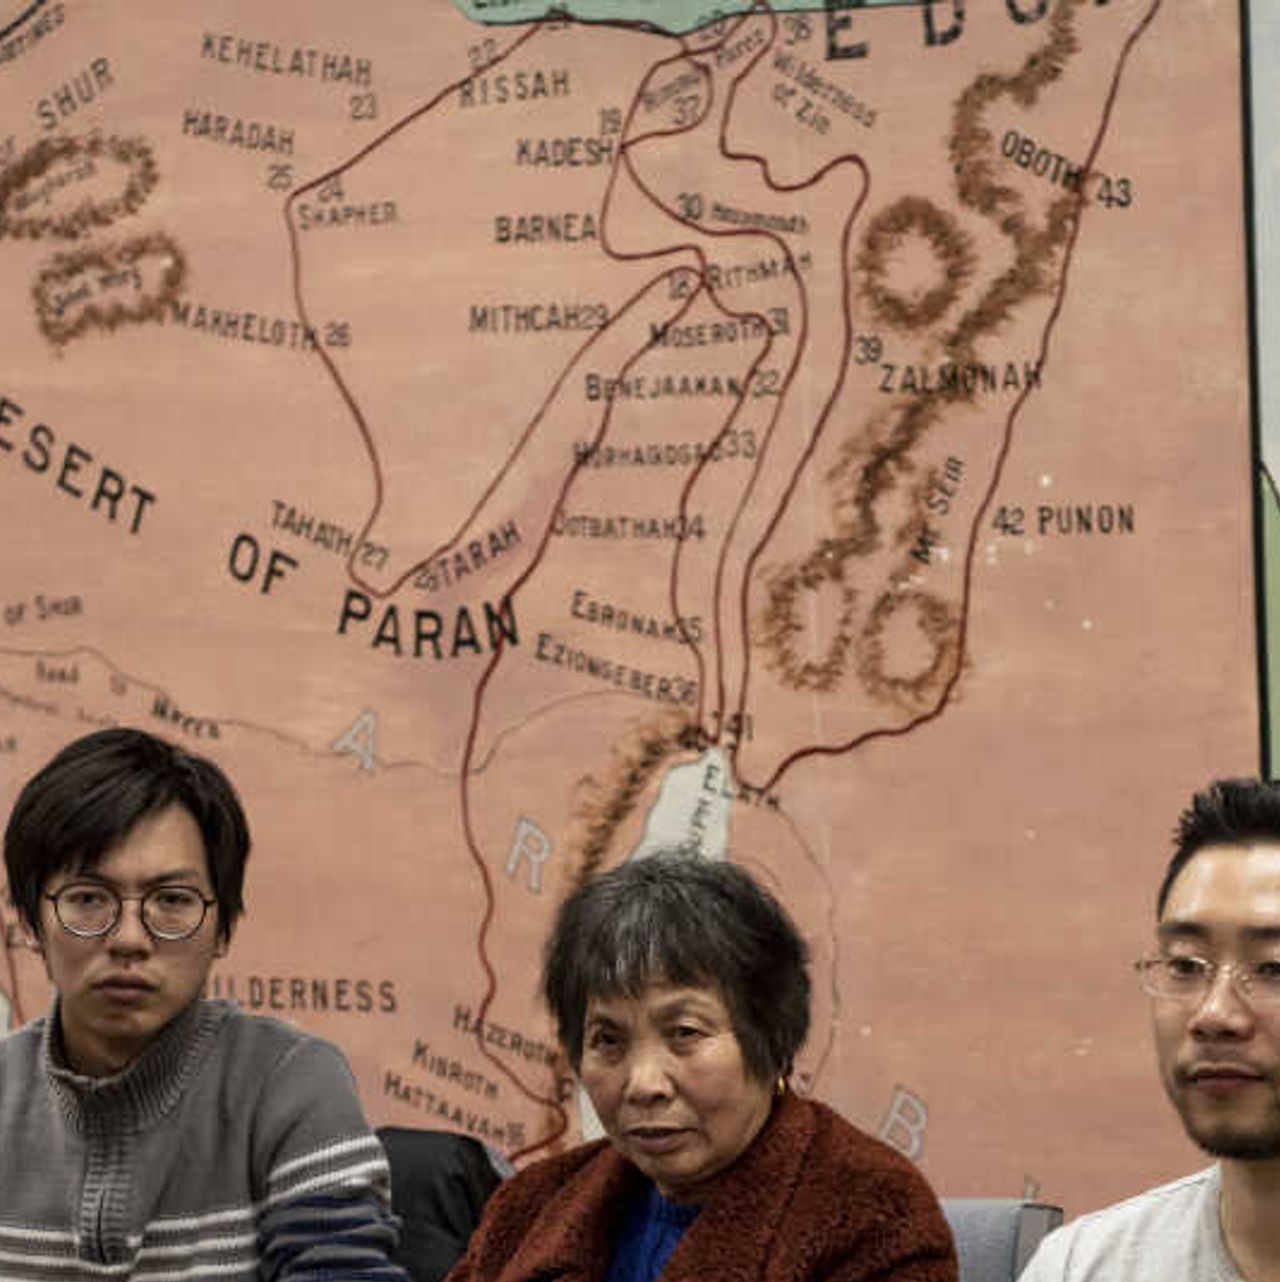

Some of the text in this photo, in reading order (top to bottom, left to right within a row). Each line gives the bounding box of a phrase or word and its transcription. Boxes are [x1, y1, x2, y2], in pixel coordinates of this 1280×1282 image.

[459, 70, 570, 108] RISSAH
[182, 109, 295, 155] HARADAH
[517, 137, 613, 168] KADESH
[1001, 131, 1132, 208] OBOTH 43
[495, 213, 597, 244] BARNEA
[992, 504, 1136, 535] 42 PUNON
[228, 534, 298, 595] OF
[337, 589, 520, 660] PARAN
